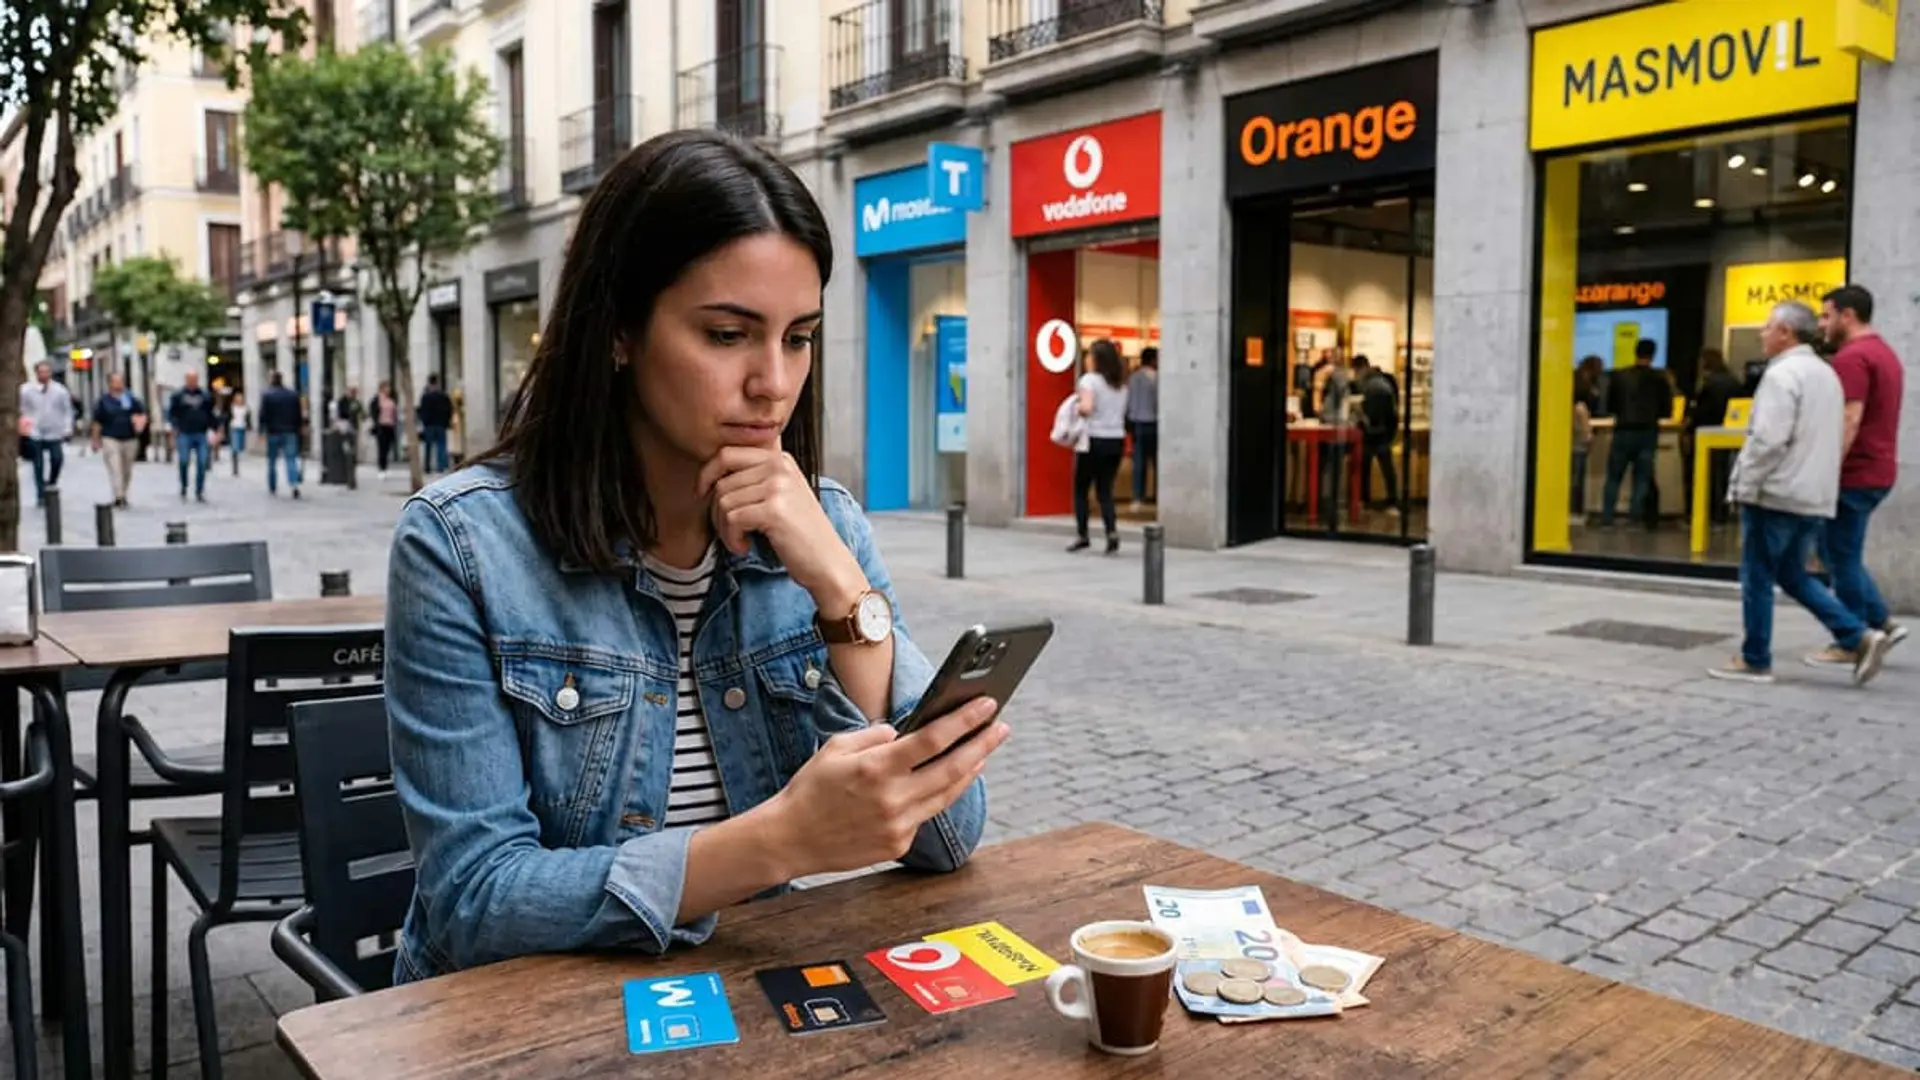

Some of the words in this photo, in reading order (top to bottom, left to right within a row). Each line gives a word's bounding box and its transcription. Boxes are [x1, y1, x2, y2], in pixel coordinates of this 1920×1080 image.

[1240, 100, 1416, 166] Orange
[941, 160, 968, 196] T
[1041, 190, 1128, 222] vodafone
[333, 642, 381, 665] CAFÉ
[1234, 929, 1279, 961] 20
